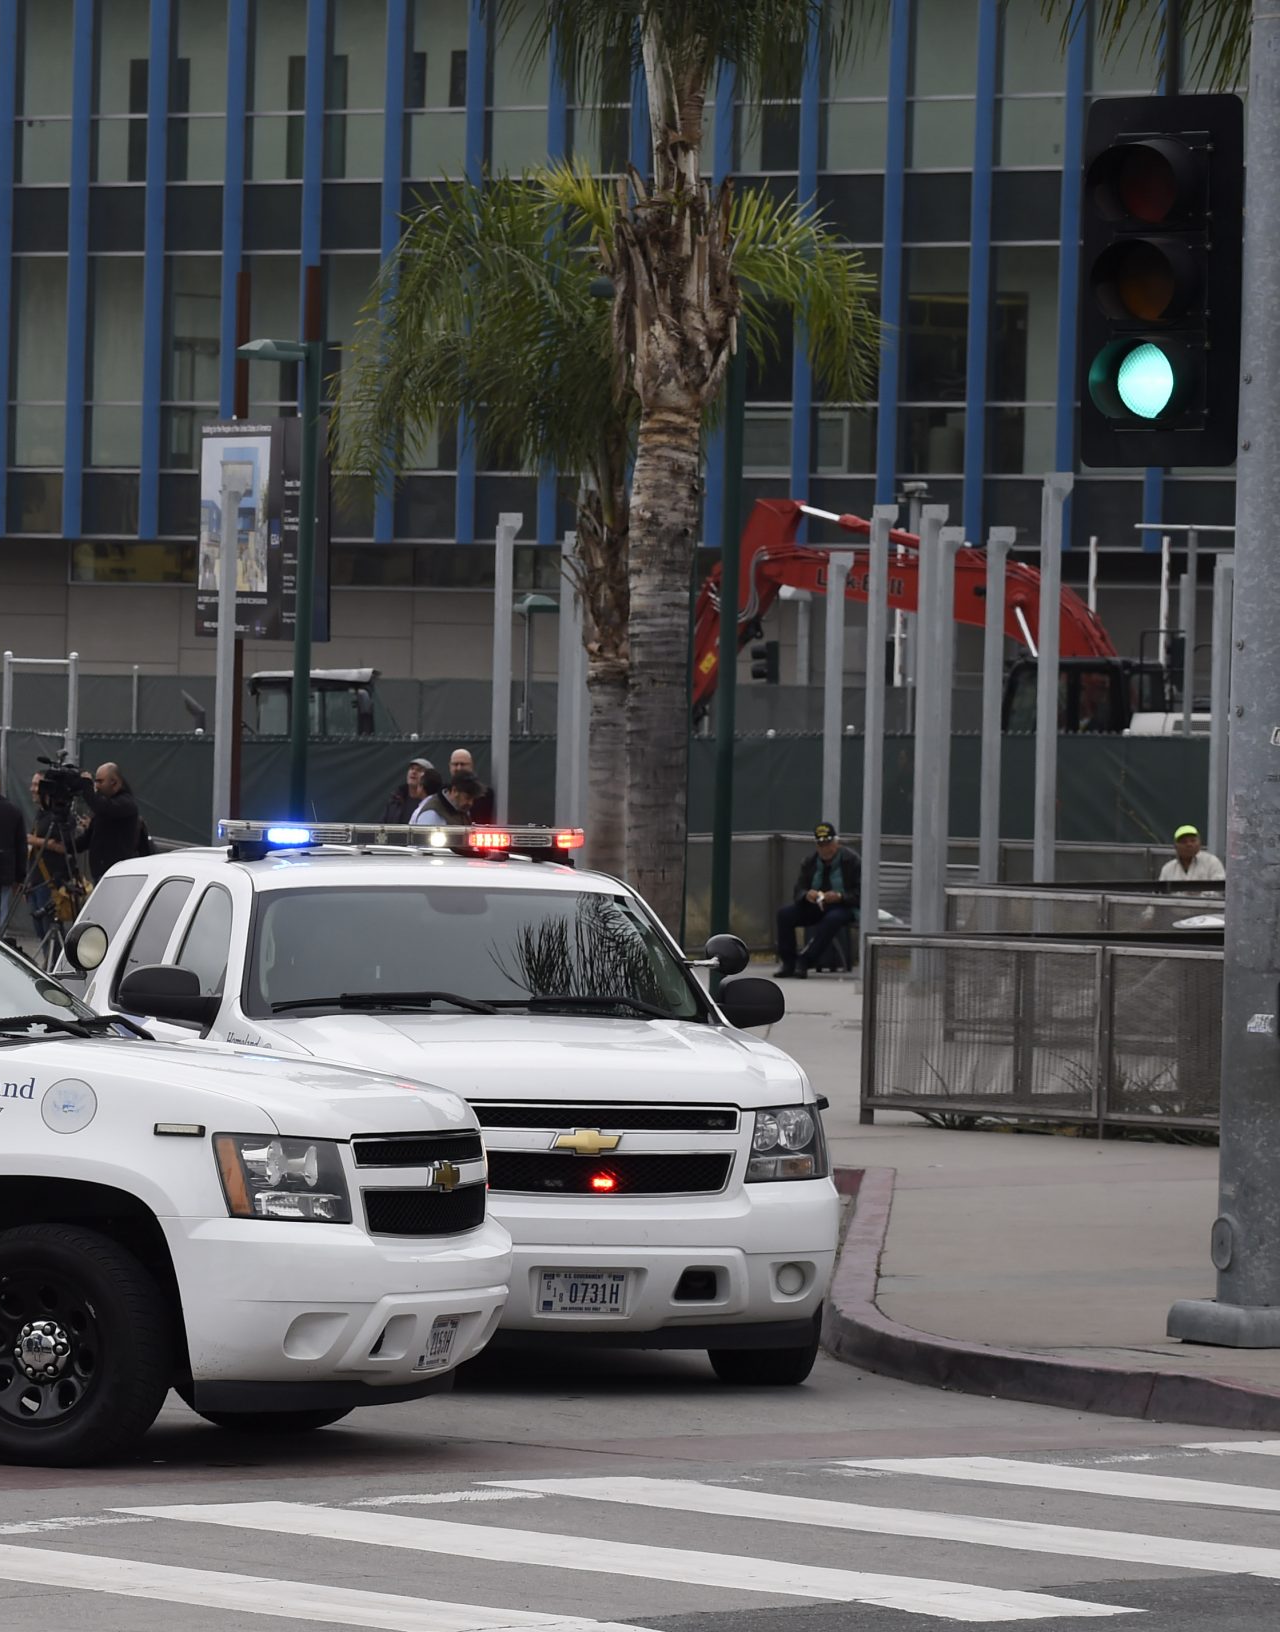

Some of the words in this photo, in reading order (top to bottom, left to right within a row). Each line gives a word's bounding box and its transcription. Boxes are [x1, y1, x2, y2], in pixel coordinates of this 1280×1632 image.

[817, 567, 903, 596] Lk-Blt
[226, 1031, 262, 1047] Homeland
[569, 1282, 620, 1304] 0731H
